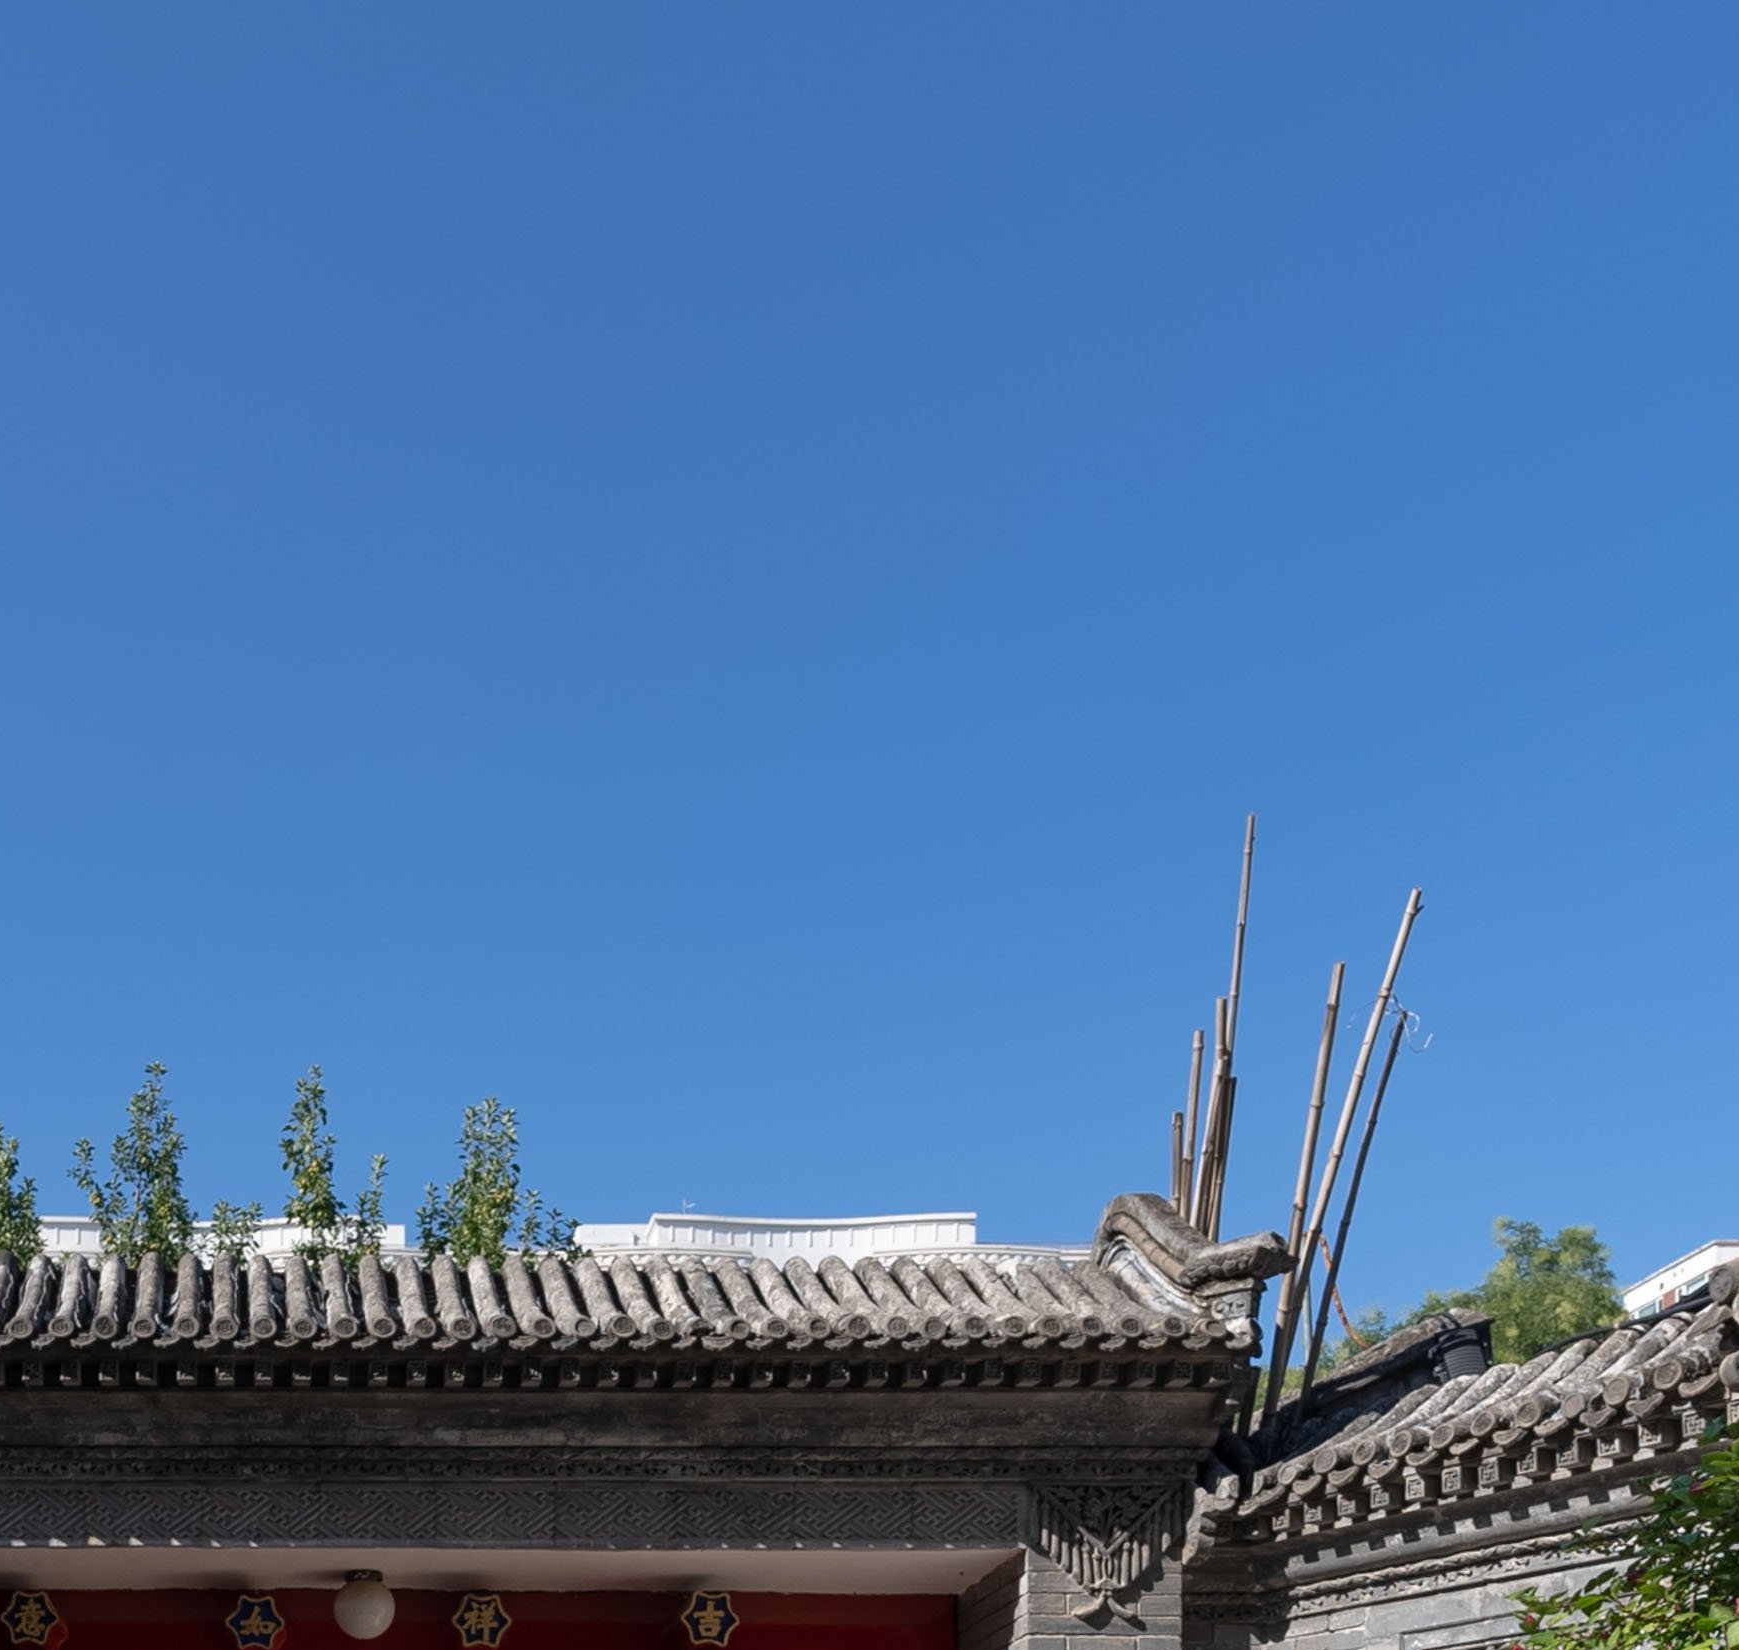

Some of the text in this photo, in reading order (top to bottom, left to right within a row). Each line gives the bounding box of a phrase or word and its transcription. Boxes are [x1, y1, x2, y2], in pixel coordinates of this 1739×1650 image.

[14, 1598, 45, 1636] 意
[239, 1605, 277, 1636] 如
[462, 1601, 499, 1641] 祥
[693, 1600, 725, 1637] 吉
